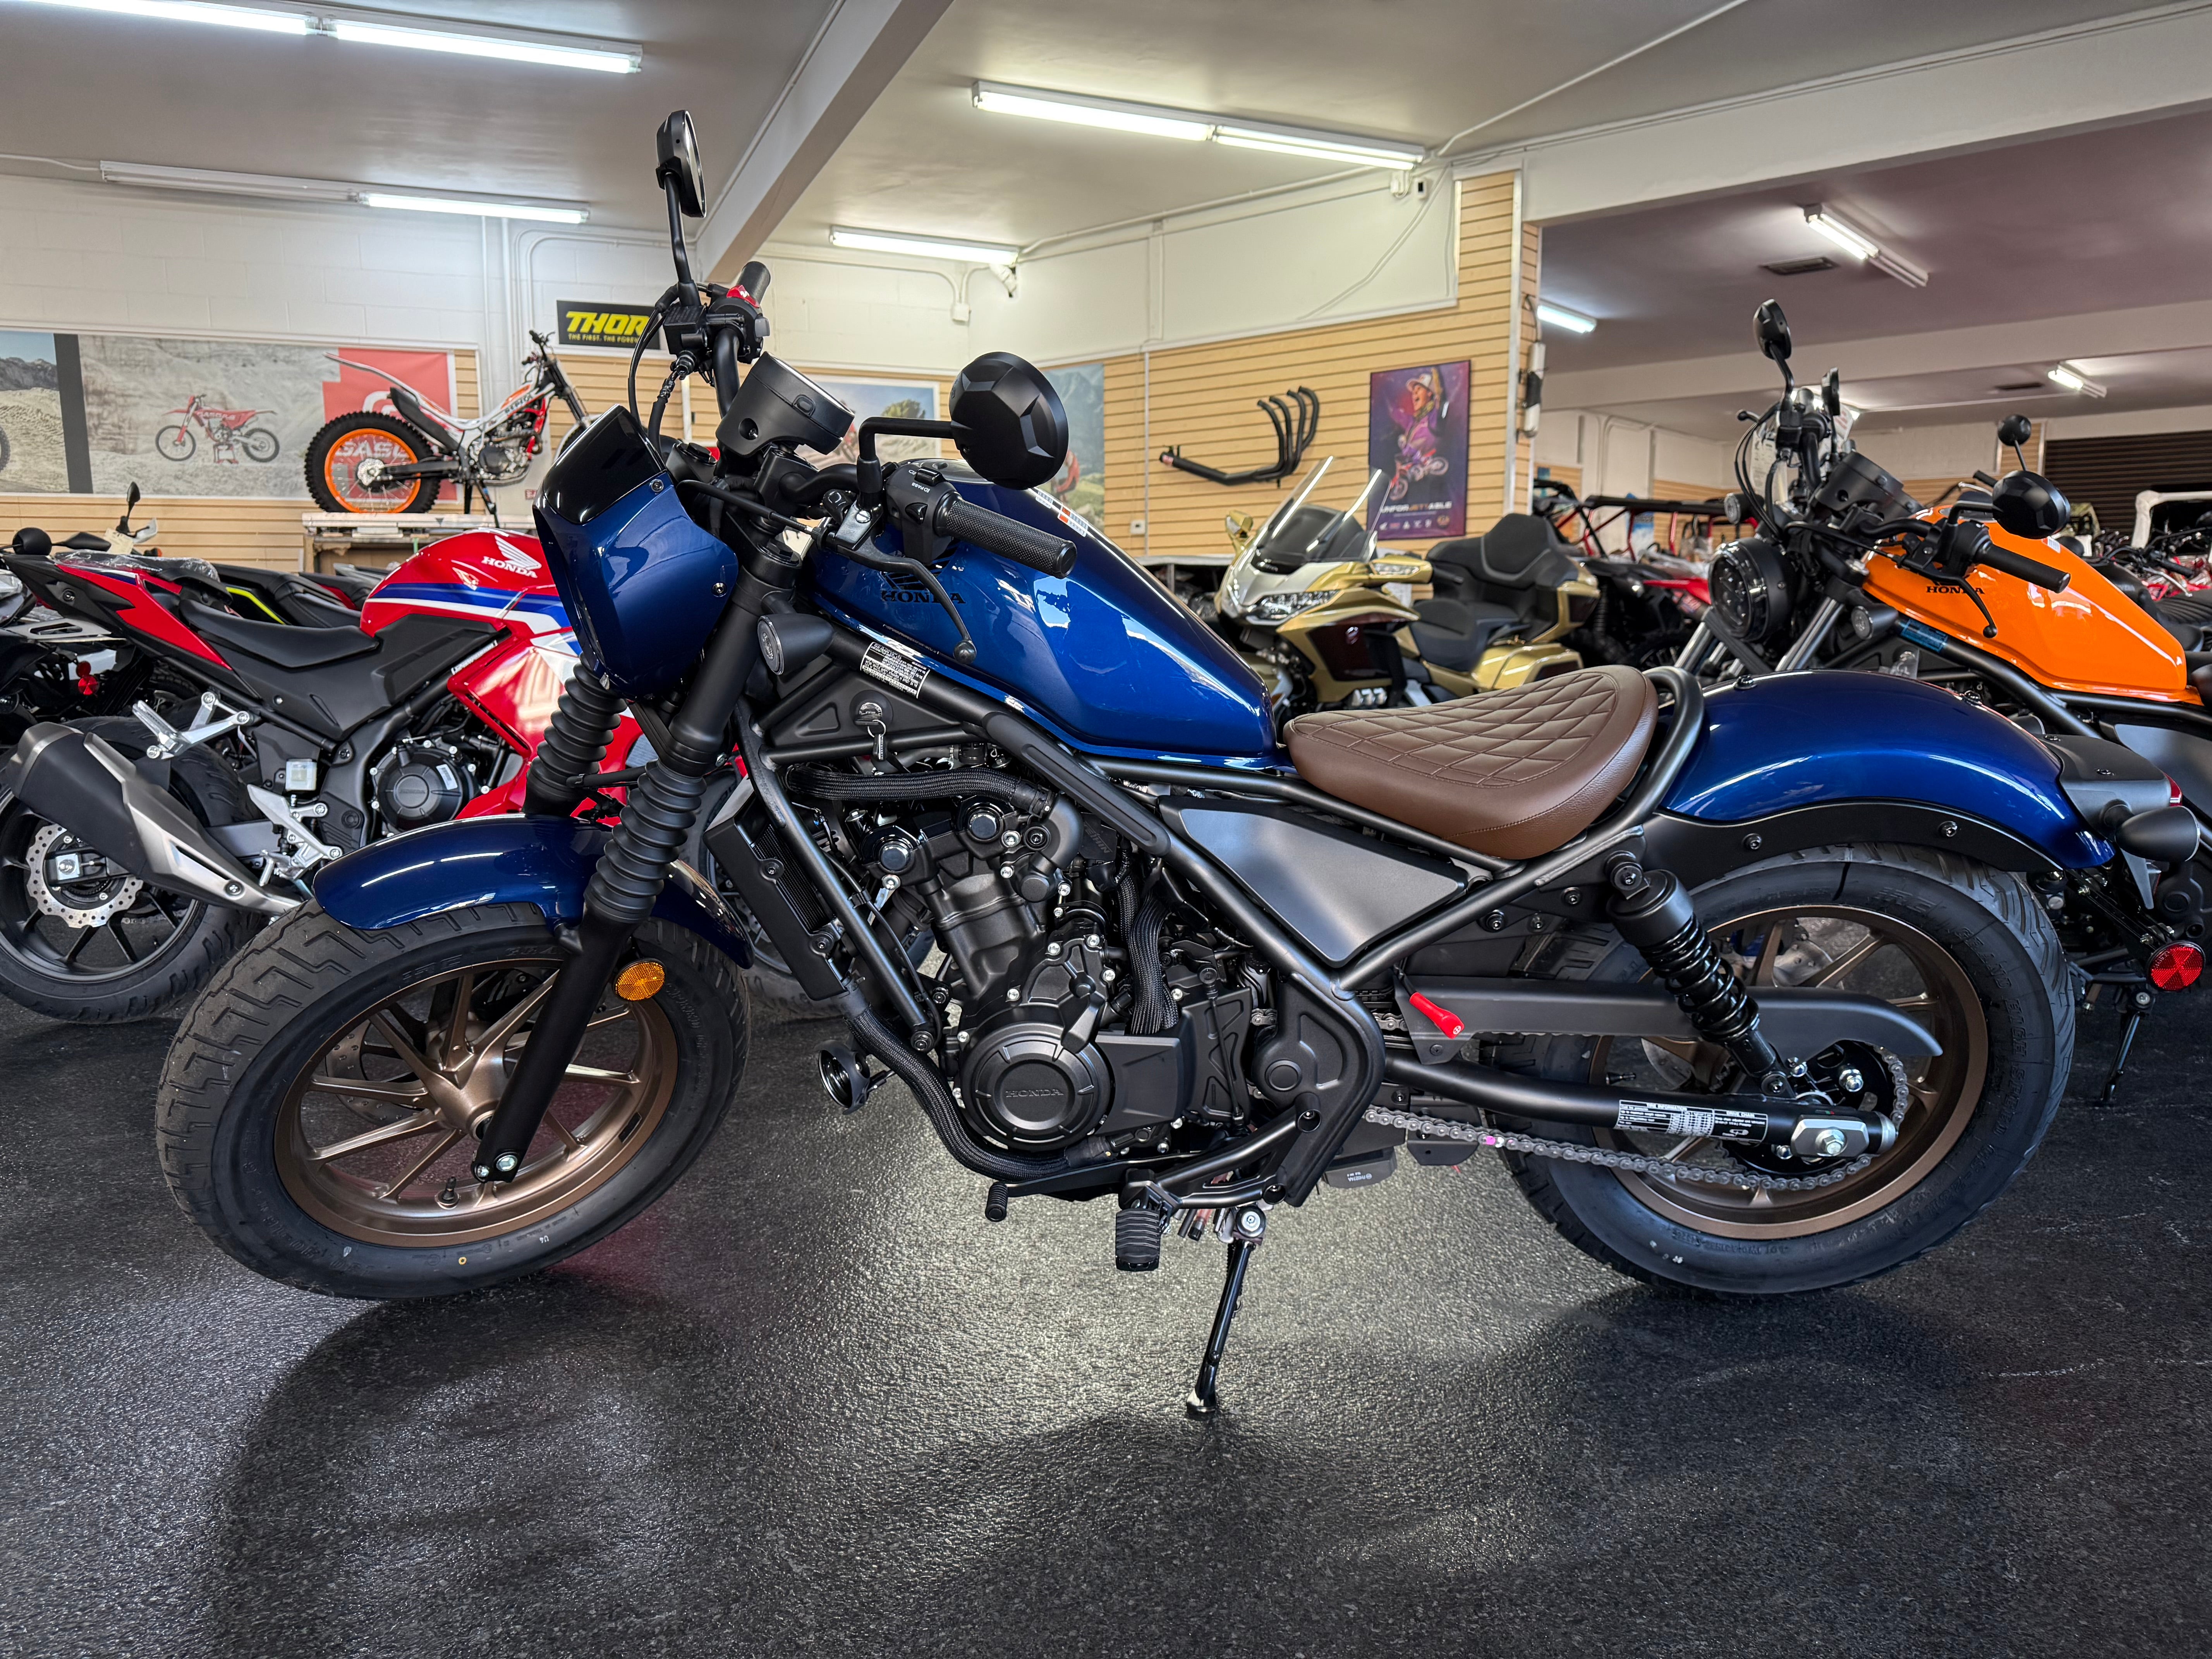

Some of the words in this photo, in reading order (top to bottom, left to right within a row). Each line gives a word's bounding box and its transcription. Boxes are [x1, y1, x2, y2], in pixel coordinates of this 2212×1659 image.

[566, 311, 650, 336] THOR
[481, 556, 538, 579] HONDA
[880, 590, 966, 604] HONA
[1926, 586, 1985, 594] HONA
[1005, 1089, 1064, 1098] HONDA
